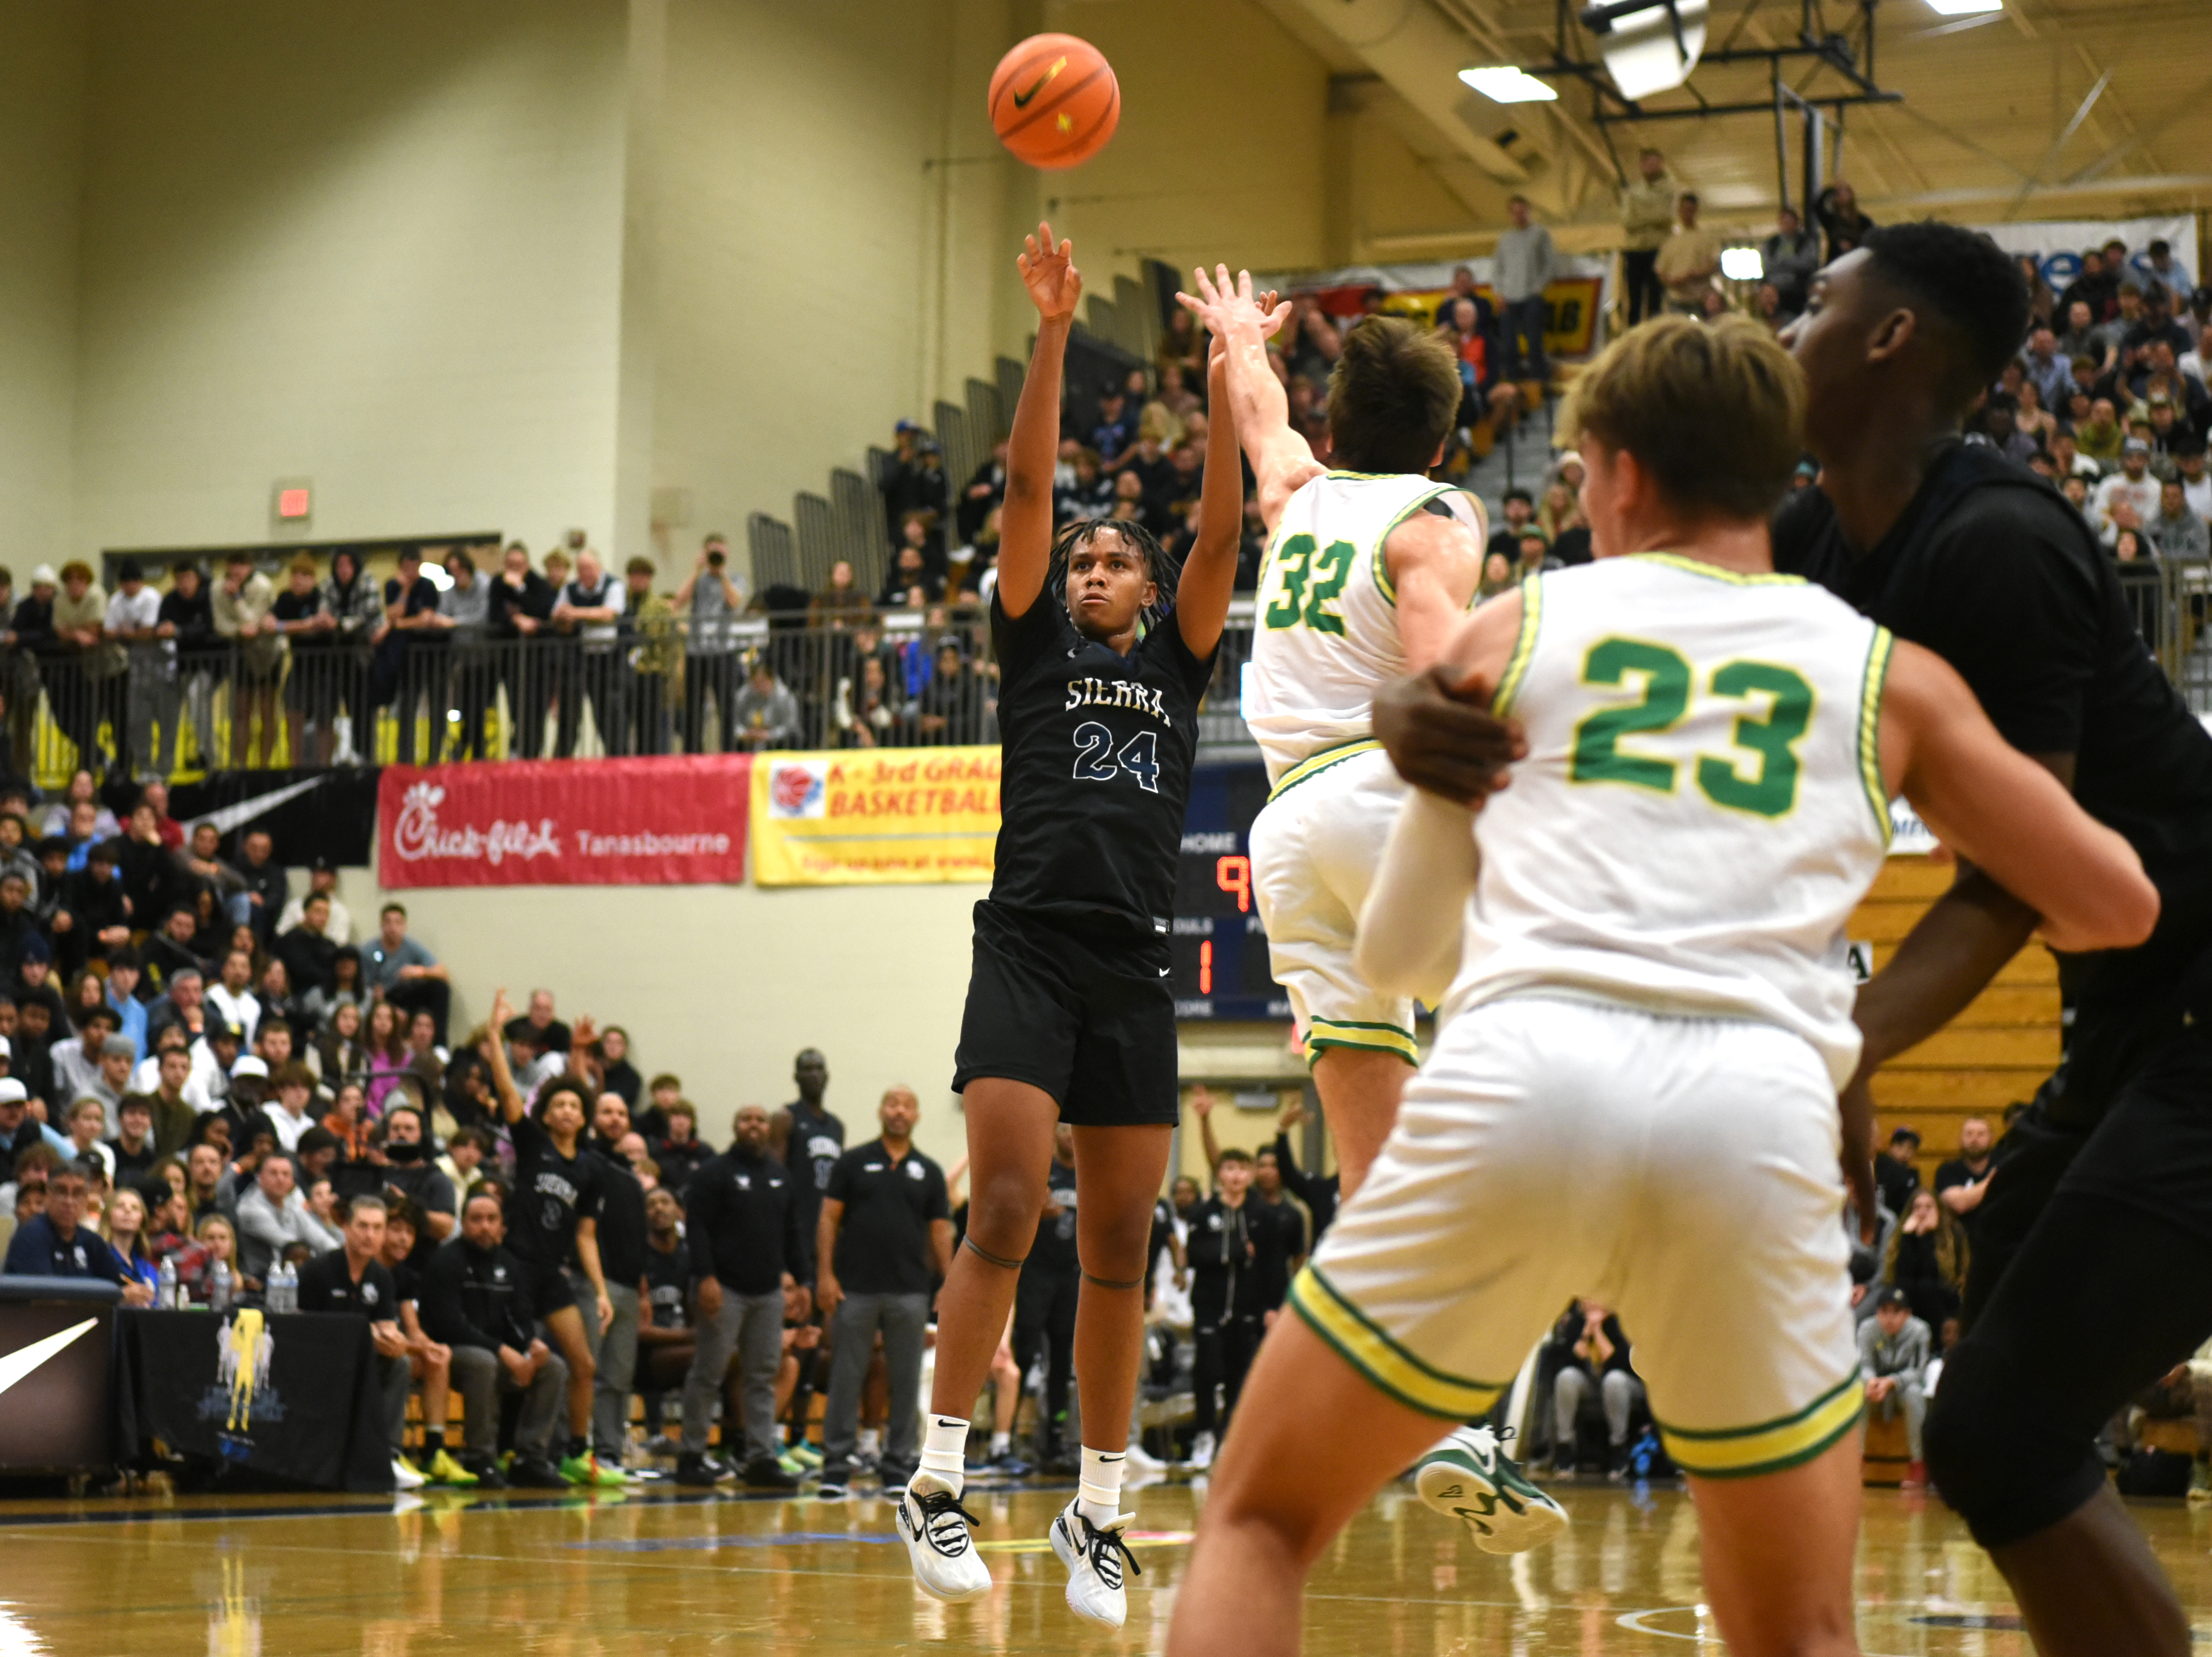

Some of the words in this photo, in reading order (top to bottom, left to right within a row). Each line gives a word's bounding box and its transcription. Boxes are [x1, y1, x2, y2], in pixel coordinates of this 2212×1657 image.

[1265, 531, 1357, 639] 32
[1065, 677, 1171, 728] SIERRA
[1567, 633, 1817, 821] 23
[1073, 721, 1159, 793] 24
[576, 829, 730, 857] Tanasbourne
[1217, 856, 1250, 912] 9
[1200, 940, 1212, 994] 1
